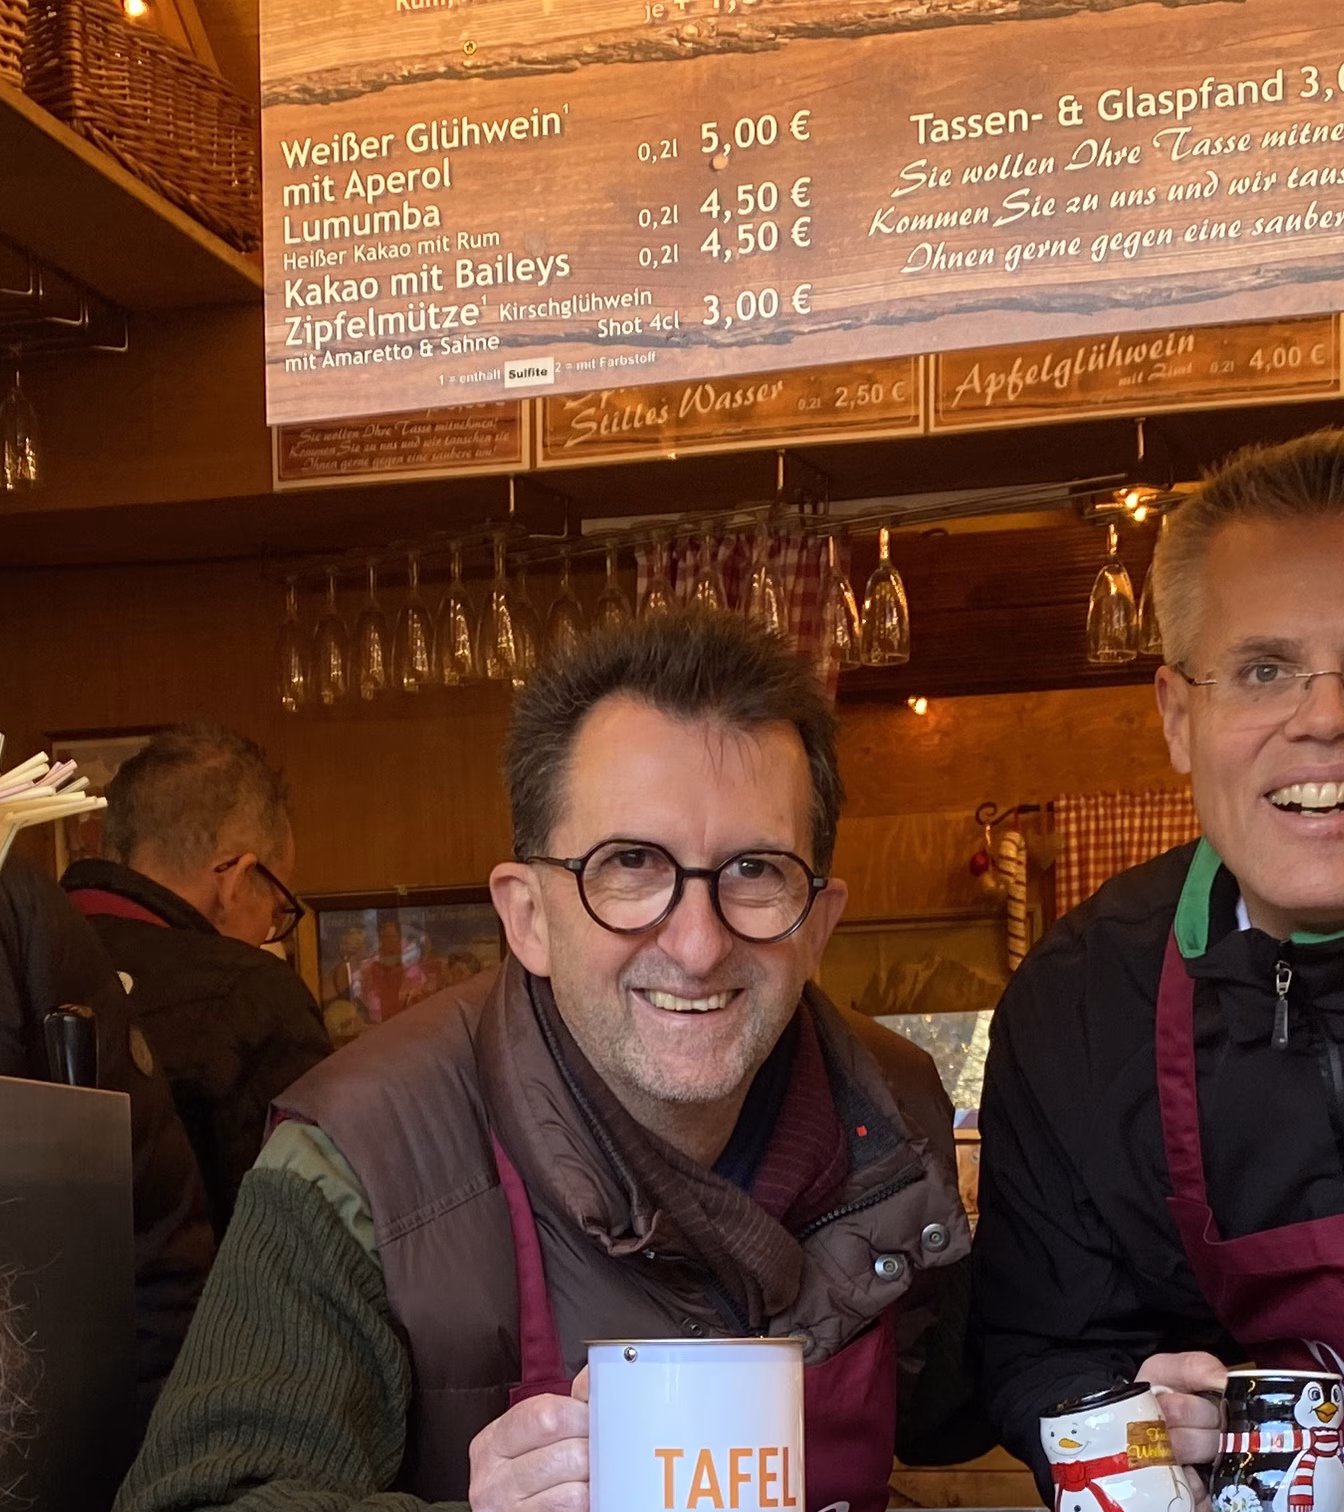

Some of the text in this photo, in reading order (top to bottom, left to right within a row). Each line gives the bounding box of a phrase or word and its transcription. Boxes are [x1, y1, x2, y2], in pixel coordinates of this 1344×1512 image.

[910, 109, 1043, 145] Tassen-
[1058, 95, 1083, 127] &
[1098, 68, 1284, 121] Glaspfand
[281, 131, 394, 169] Weißer
[283, 110, 811, 206] mit Aperol 0,2l 5,00 €
[890, 158, 952, 198] Sie
[961, 153, 1054, 185] wollen
[1064, 137, 1141, 171] Ihre
[1153, 126, 1251, 162] Tasse
[284, 177, 811, 244] Lumumba 0,2l 4,50 €
[868, 206, 989, 237] Kommen
[992, 187, 1055, 227] Sie
[1065, 192, 1098, 213] zu
[1109, 187, 1156, 208] uns
[1167, 170, 1219, 201] und
[1227, 171, 1277, 196] wir
[283, 231, 500, 271] Heißer Kakao mit Rum
[285, 217, 811, 308] Kakao mit Baileys 0,2l 4,50 €
[900, 241, 994, 273] Ihnen
[1004, 237, 1081, 272] gerne
[1091, 227, 1173, 263] gegen
[1183, 218, 1242, 243] eine
[499, 289, 652, 323] Kirschglühwein
[598, 284, 812, 338] Shot 4cl 3,00 €
[285, 335, 500, 373] mit Amaretto & Sahne
[508, 367, 548, 380] Sulfite
[576, 360, 596, 371] mit
[600, 351, 656, 369] Farbstoff
[951, 331, 1194, 408] Apfelglühwein
[1249, 346, 1301, 373] 4,00
[563, 403, 668, 448] Stilles
[679, 380, 783, 419] Wasser
[835, 384, 883, 410] 2,50
[654, 1446, 797, 1510] TAFEL
